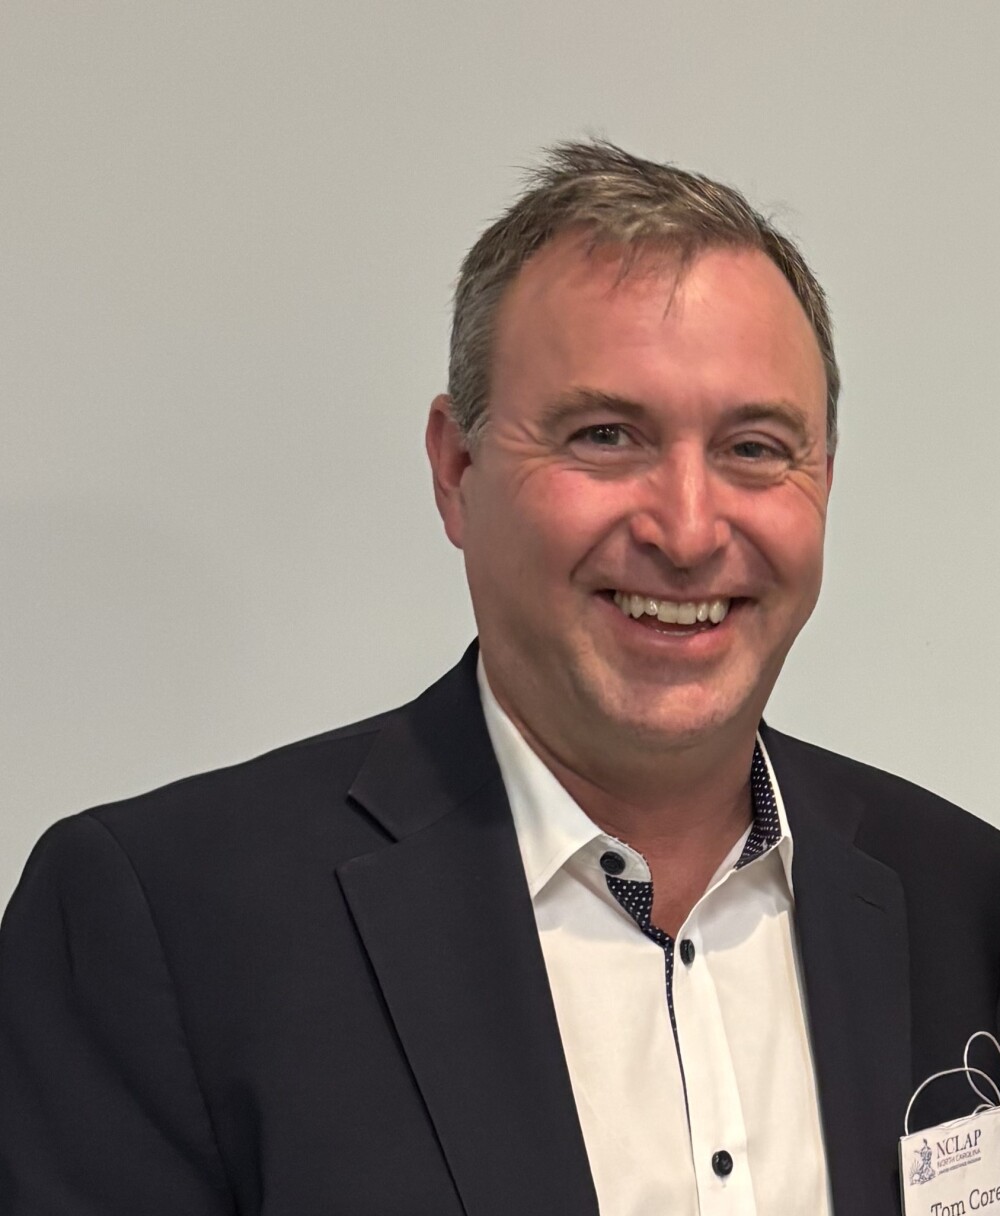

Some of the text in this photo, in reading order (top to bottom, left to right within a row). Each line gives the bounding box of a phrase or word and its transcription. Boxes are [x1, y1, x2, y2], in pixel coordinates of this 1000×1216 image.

[936, 1129, 981, 1159] NCLAP
[937, 1156, 955, 1168] NORTH
[956, 1148, 981, 1162] CAROLINA
